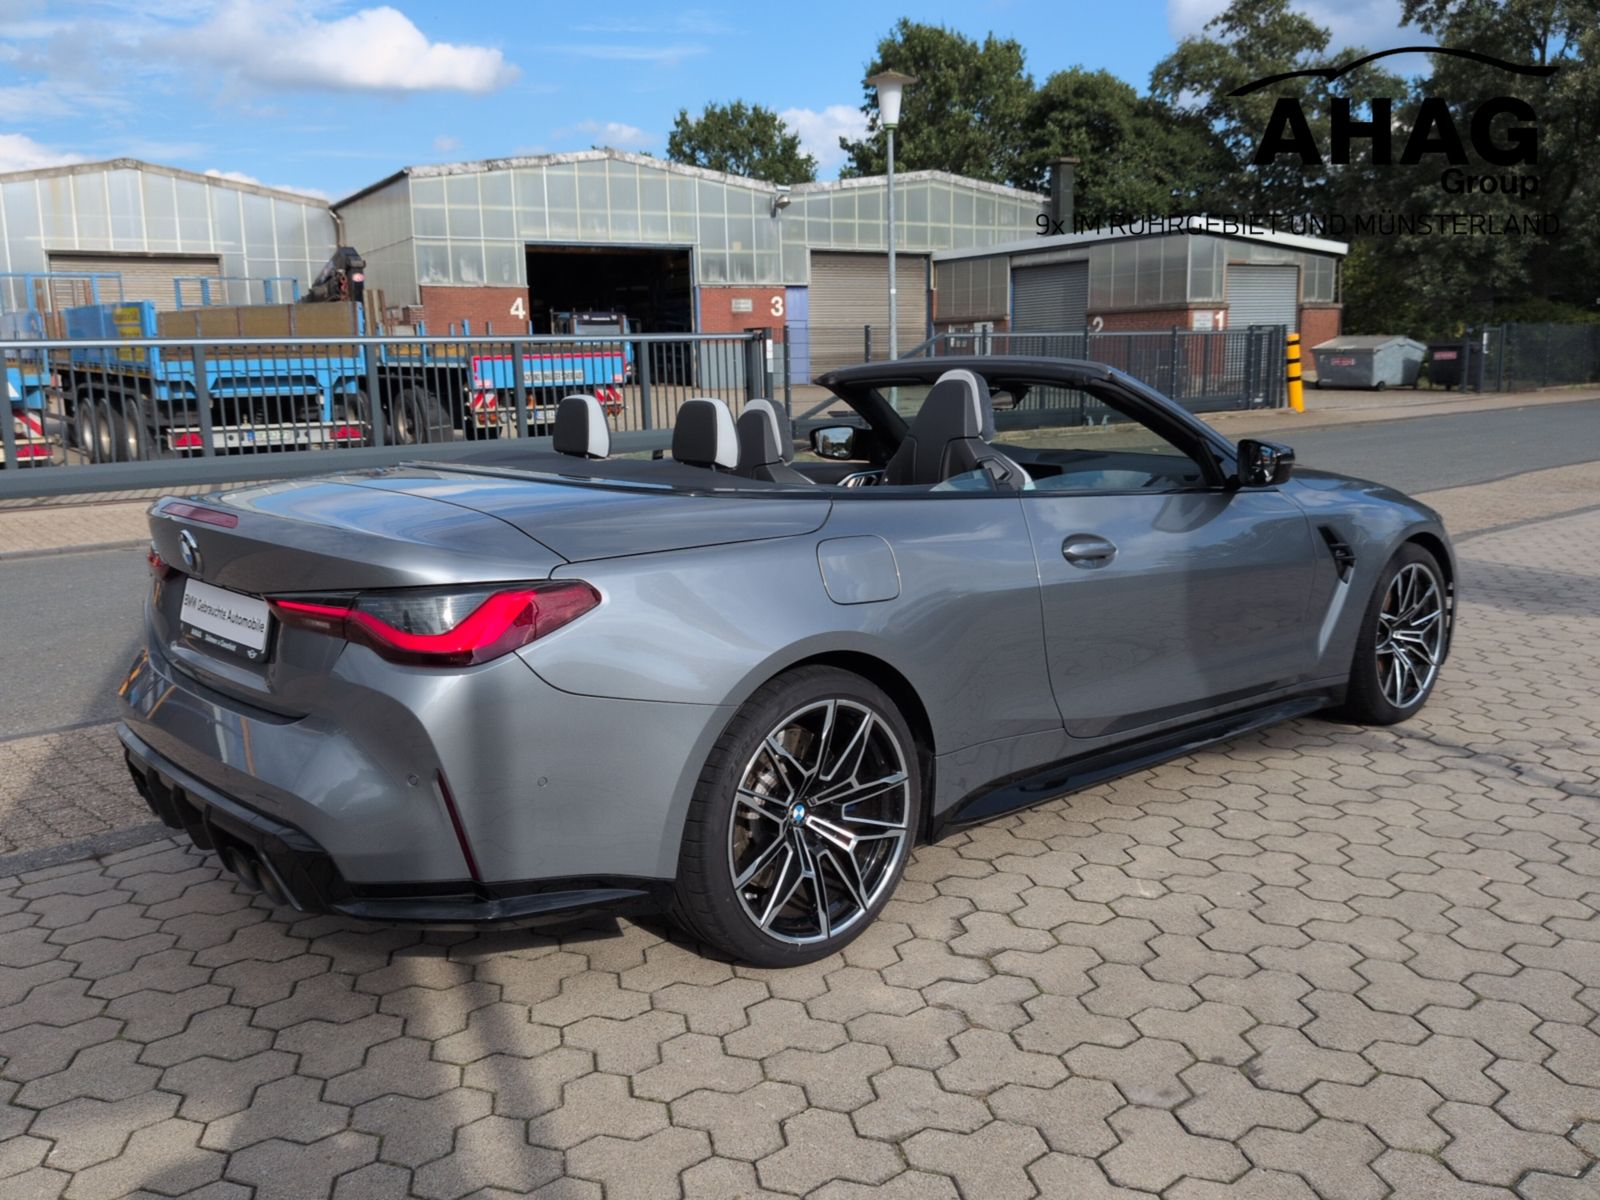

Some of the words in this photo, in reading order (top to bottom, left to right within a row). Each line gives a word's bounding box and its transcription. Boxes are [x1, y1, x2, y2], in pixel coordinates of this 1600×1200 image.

[510, 297, 526, 320] 4
[770, 295, 784, 317] 3
[1214, 310, 1225, 332] 1
[227, 609, 265, 633] Automobile
